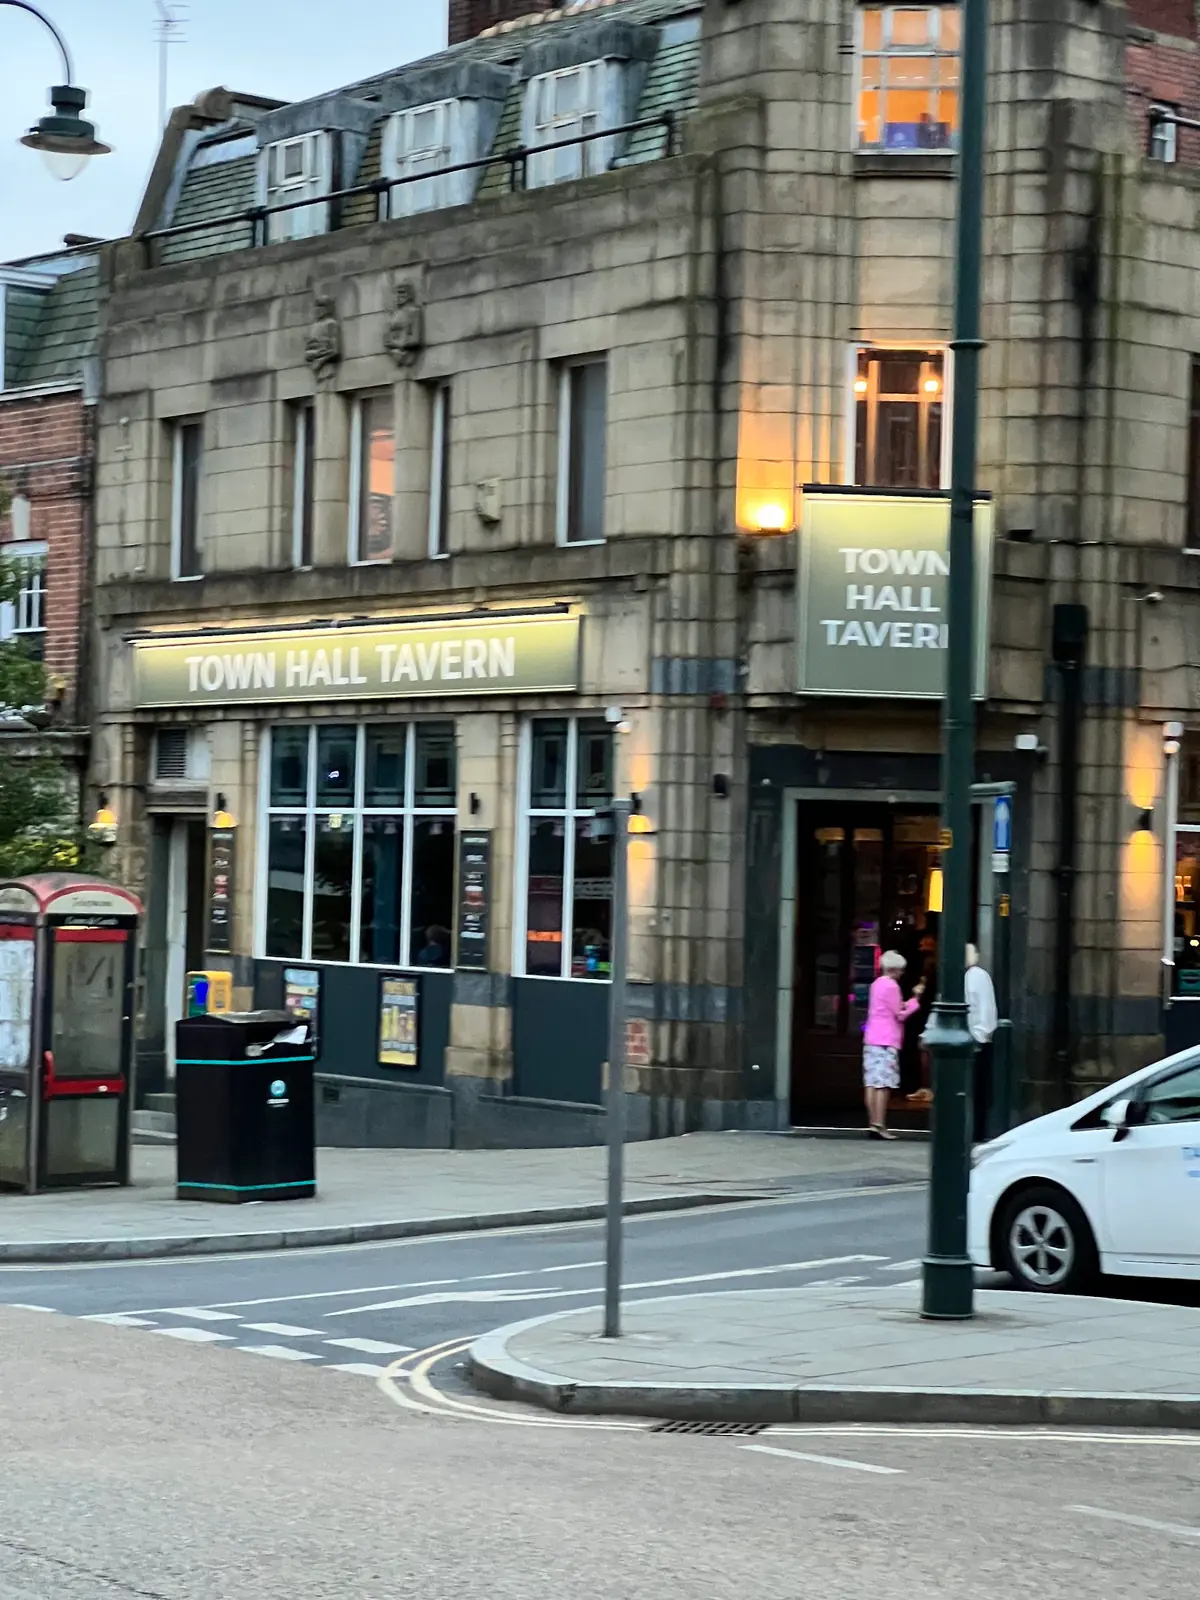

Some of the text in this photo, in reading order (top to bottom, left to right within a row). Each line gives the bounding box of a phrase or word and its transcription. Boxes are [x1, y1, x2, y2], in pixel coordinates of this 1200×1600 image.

[838, 548, 950, 576] TOWN
[846, 584, 941, 612] HALL
[184, 637, 515, 692] TOWN HALL TAVERN
